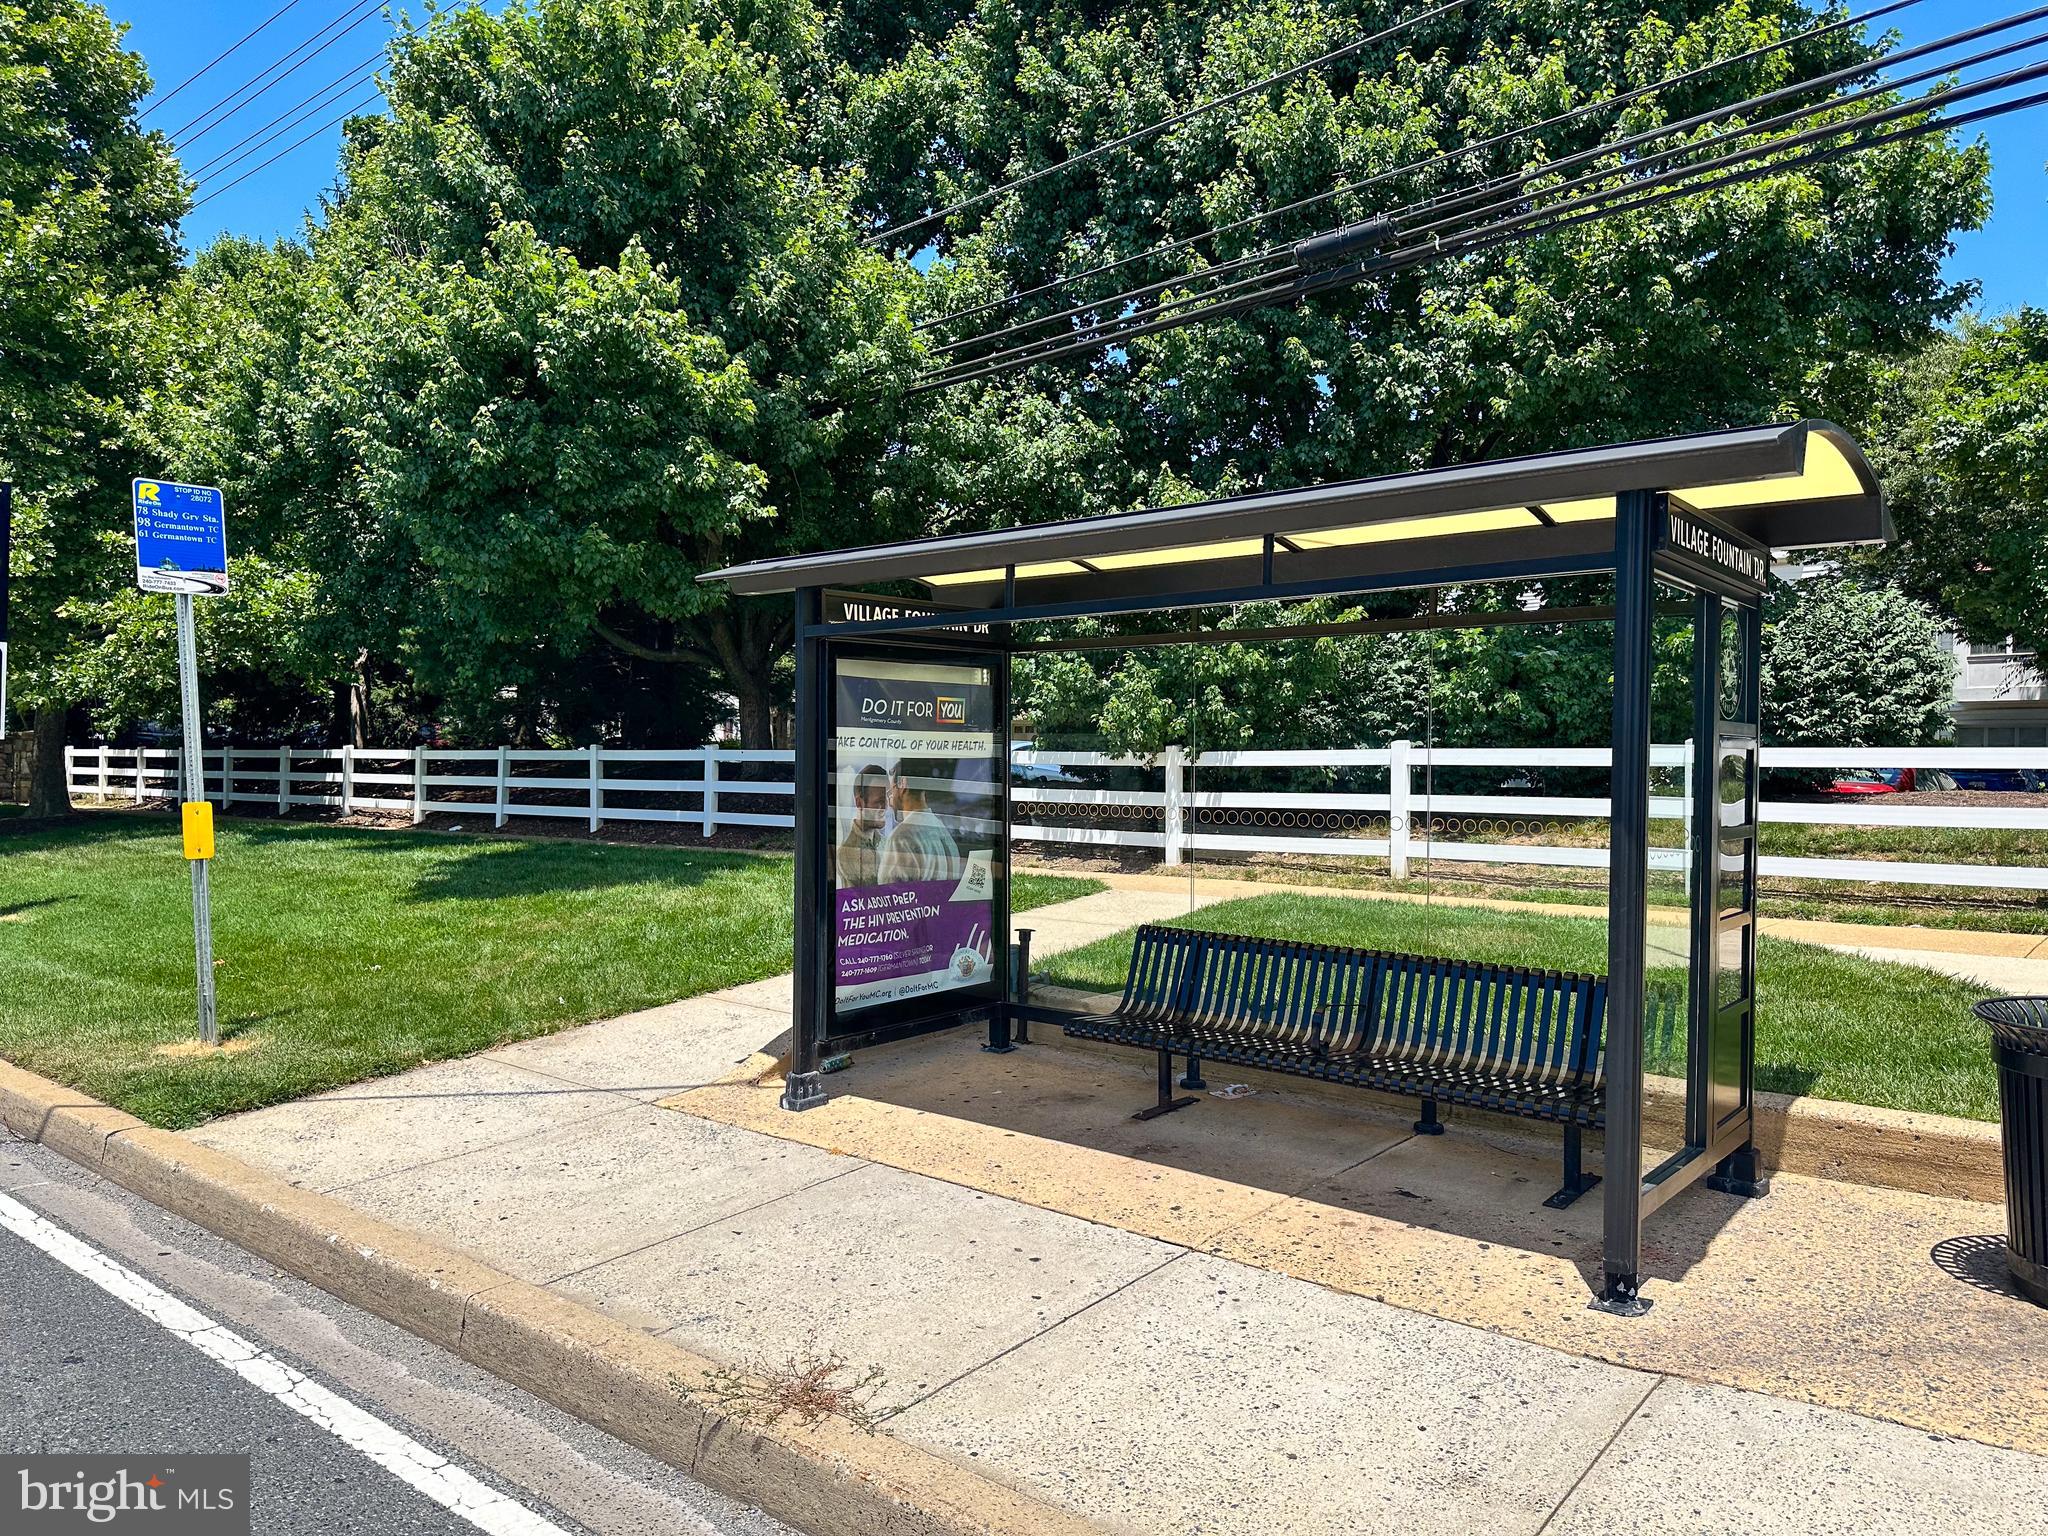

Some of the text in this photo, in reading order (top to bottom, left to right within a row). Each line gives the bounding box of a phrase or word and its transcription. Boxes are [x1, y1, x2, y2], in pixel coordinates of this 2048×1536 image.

[191, 495, 212, 503] 28072
[137, 506, 219, 523] 78 Shady Grv Sta.
[137, 517, 151, 527] 98
[154, 521, 205, 532] Germantown
[153, 531, 203, 543] Germantown
[1670, 515, 1766, 583] VILLAGE FOUNTAIN DR.
[843, 603, 899, 622] VILLAGE
[862, 698, 962, 718] DO IT FOR YOU
[859, 737, 907, 750] CONTROL
[910, 739, 923, 750] OF
[926, 740, 948, 751] YOUR
[951, 740, 986, 751] HEALTH.
[841, 898, 866, 913] ASK
[867, 895, 892, 910] ABOUT
[842, 905, 941, 931] THE HIV PREVENTION
[838, 927, 909, 947] MEDICATION.
[839, 957, 857, 966] CALL
